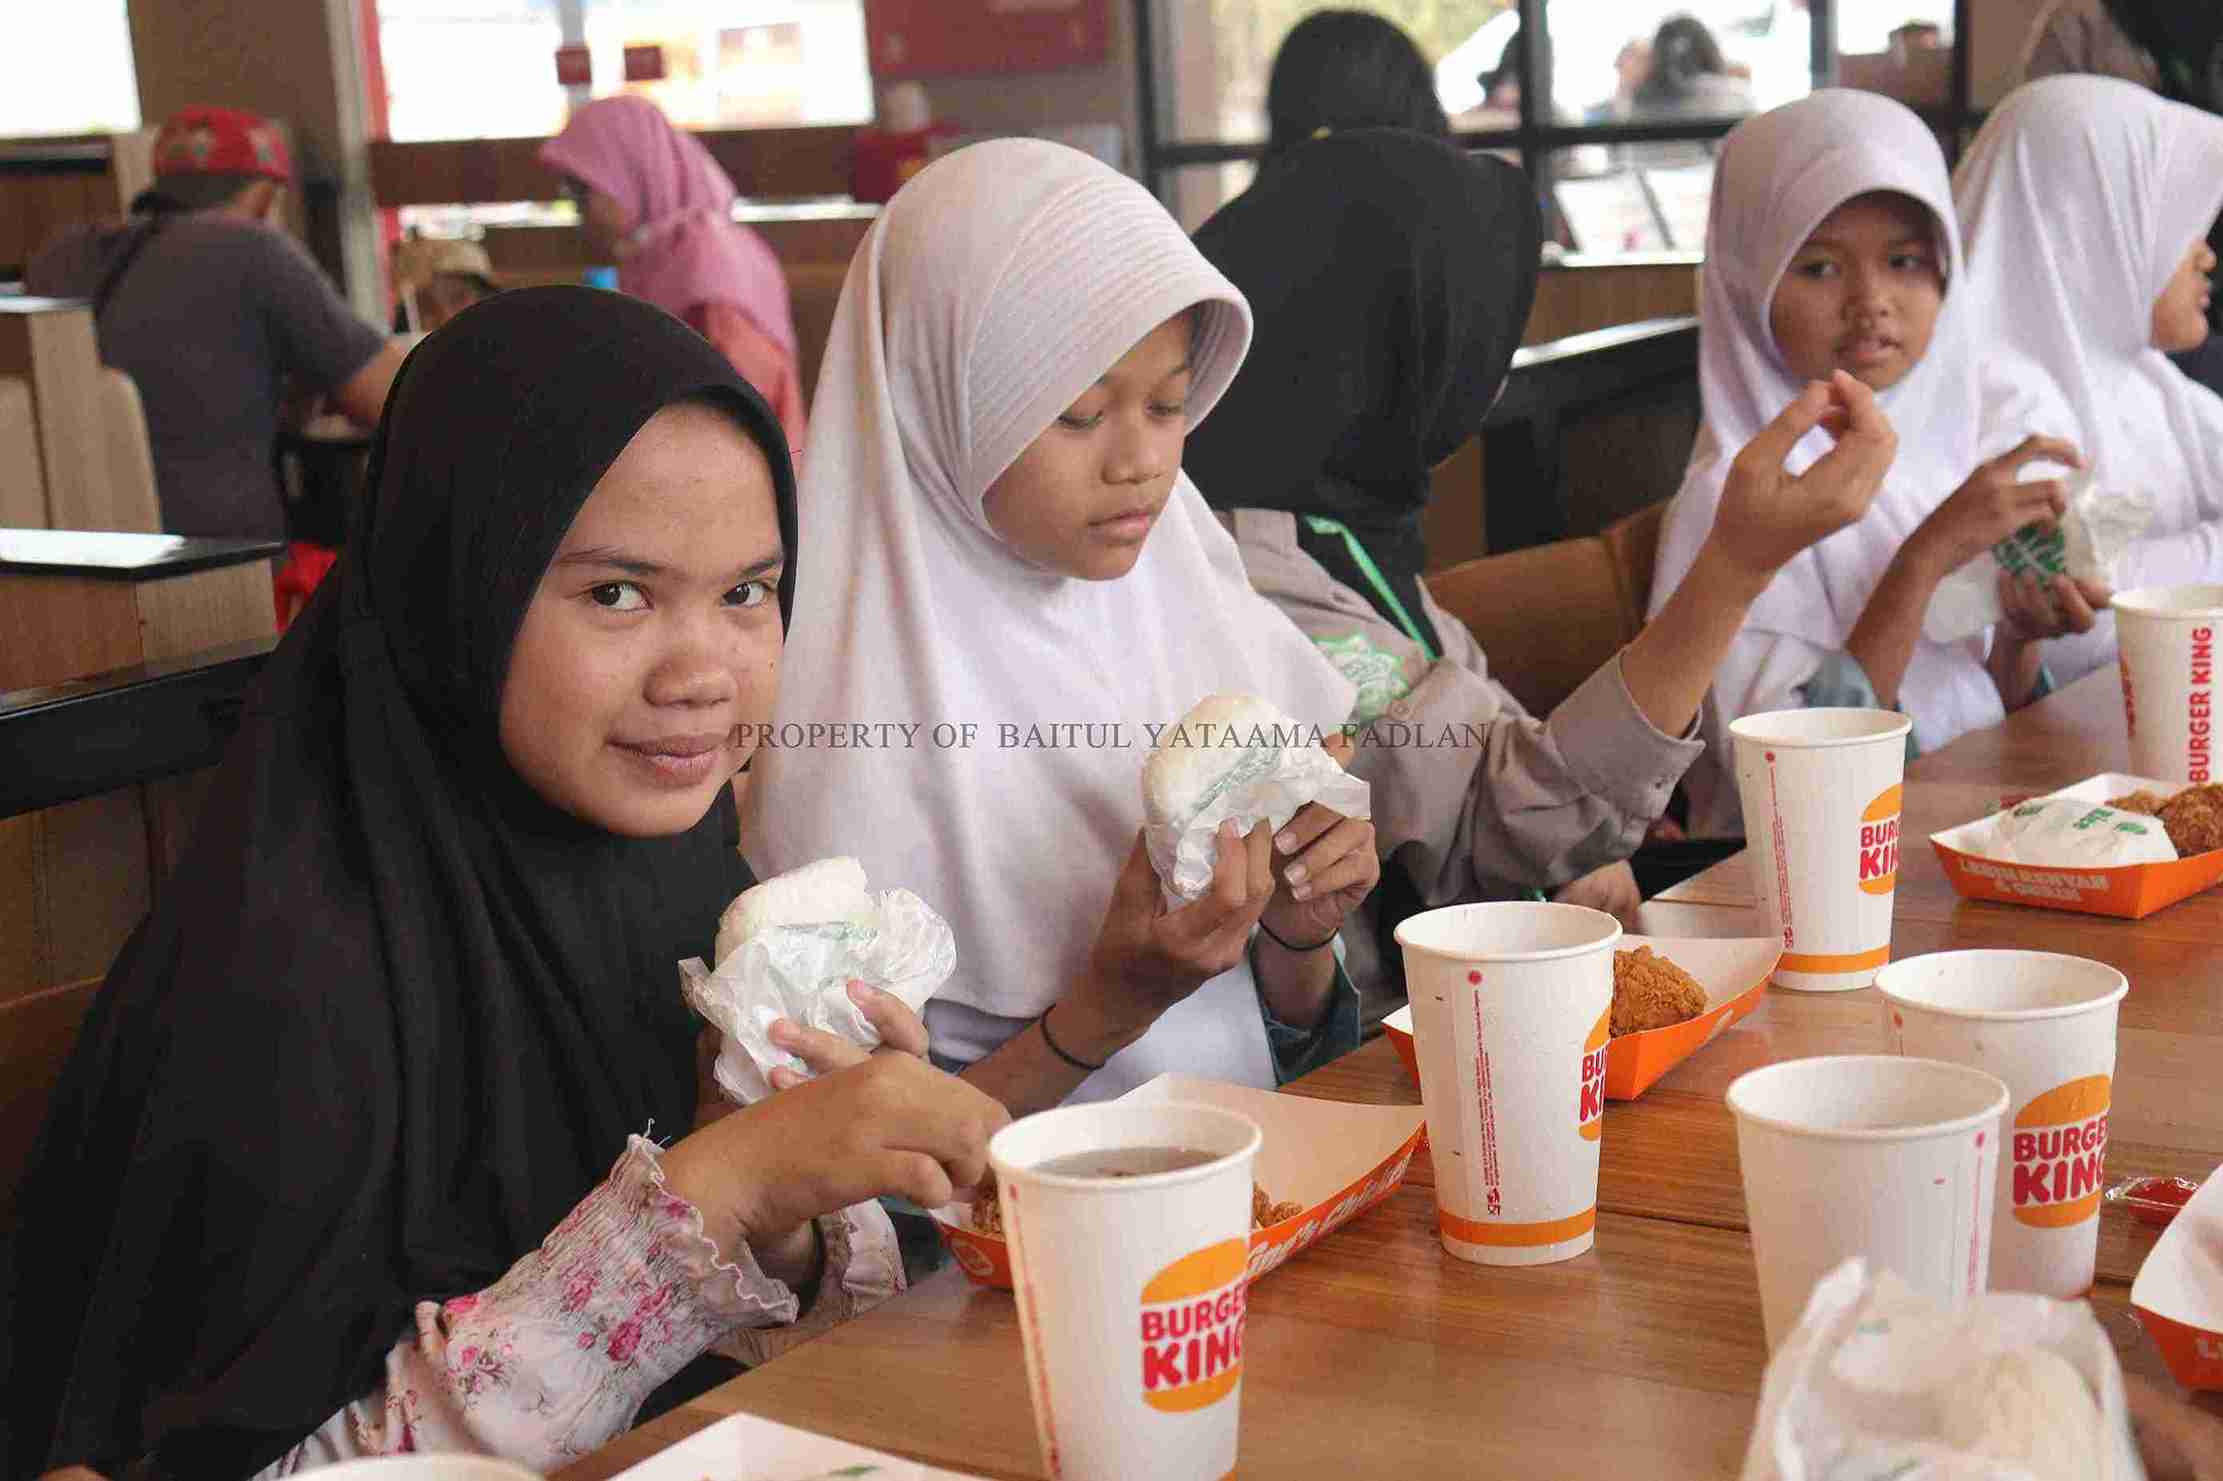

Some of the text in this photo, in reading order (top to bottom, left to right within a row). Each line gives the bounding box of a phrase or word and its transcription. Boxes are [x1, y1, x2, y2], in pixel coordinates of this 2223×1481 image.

[2189, 627, 2213, 783] BURGER KING
[1141, 1281, 1247, 1341] BURGE
